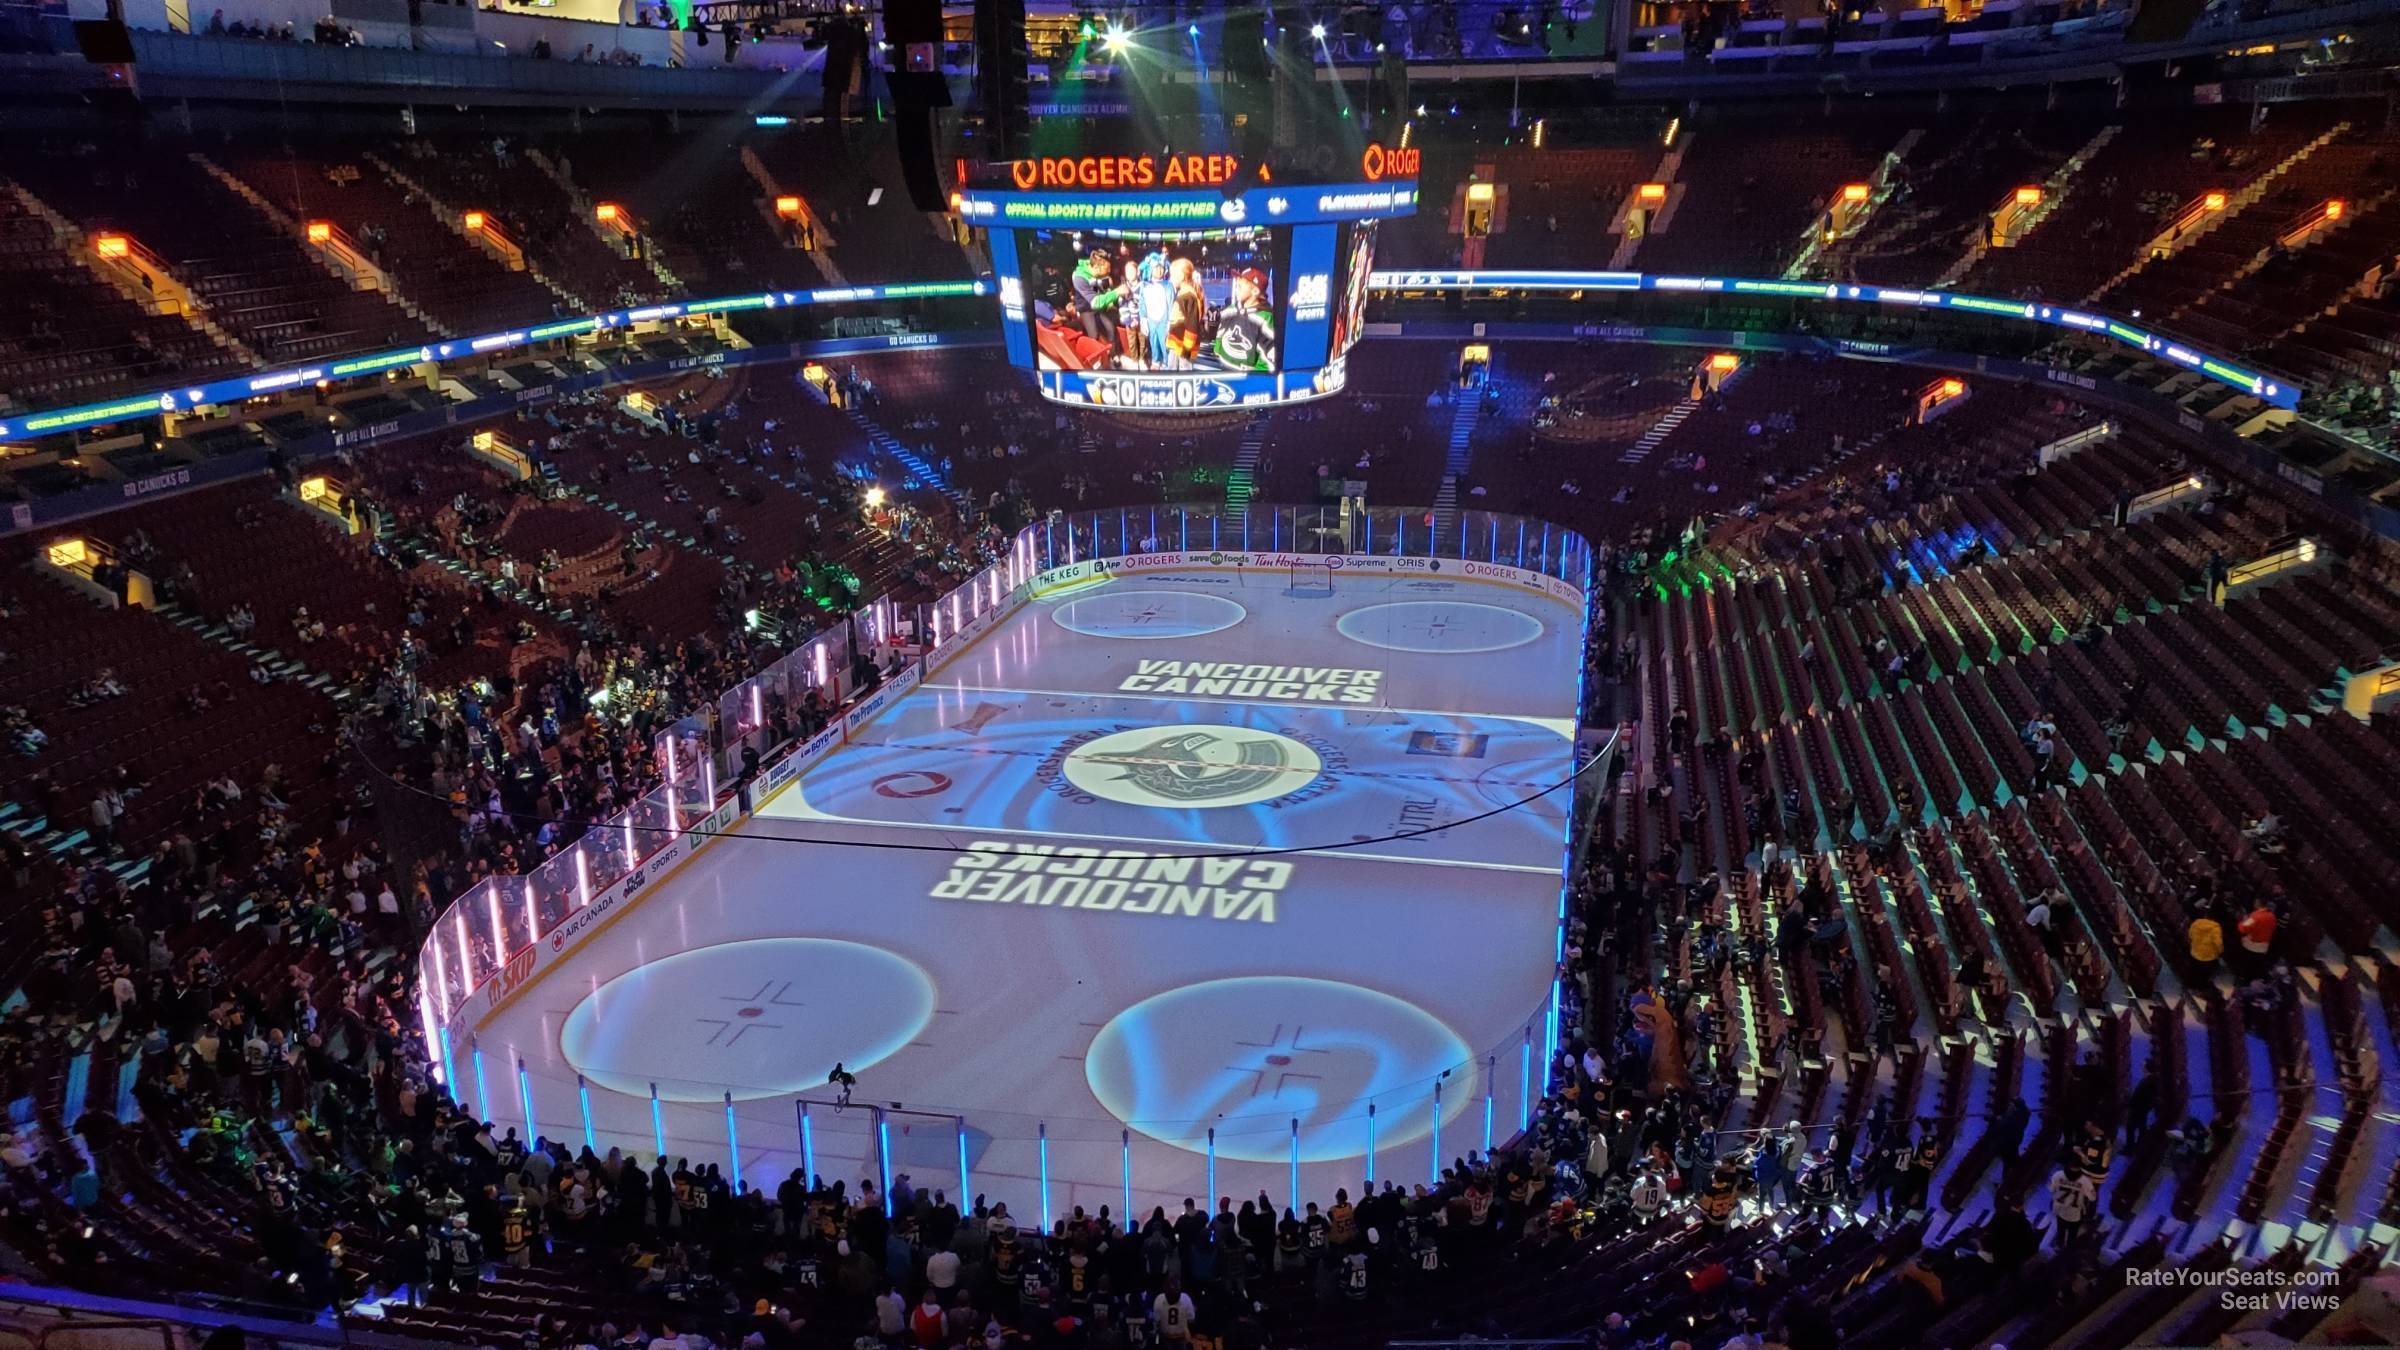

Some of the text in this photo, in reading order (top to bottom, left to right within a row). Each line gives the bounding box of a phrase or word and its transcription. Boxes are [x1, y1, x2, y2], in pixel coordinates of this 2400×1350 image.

[1043, 157, 1153, 185] ROGERS
[1006, 203, 1047, 217] OFFICIAL
[1048, 204, 1094, 217] SPORTS
[1095, 204, 1151, 217] BETTING
[1152, 202, 1216, 217] PARTNER
[1121, 381, 1135, 405] 0
[1177, 381, 1192, 406] 0
[1138, 555, 1181, 566] ROGERS
[1254, 554, 1273, 566] Tim
[1346, 558, 1386, 568] Supreme
[1397, 558, 1425, 567] ORIS
[1038, 567, 1080, 586] THE KEG
[1477, 565, 1517, 580] ROGERS
[1138, 659, 1382, 686] VANCOUVER
[1118, 675, 1377, 703] CANUCKS
[850, 695, 885, 727] The Province
[811, 733, 829, 752] BOYD
[652, 847, 678, 873] SPORTS
[954, 841, 1294, 890] CANUCKS
[929, 868, 1275, 923] VANCOUVER
[566, 896, 614, 939] AIR CANADA
[503, 948, 536, 995] SKIP
[1645, 1188, 1658, 1206] 19
[1168, 1307, 1179, 1326] 8
